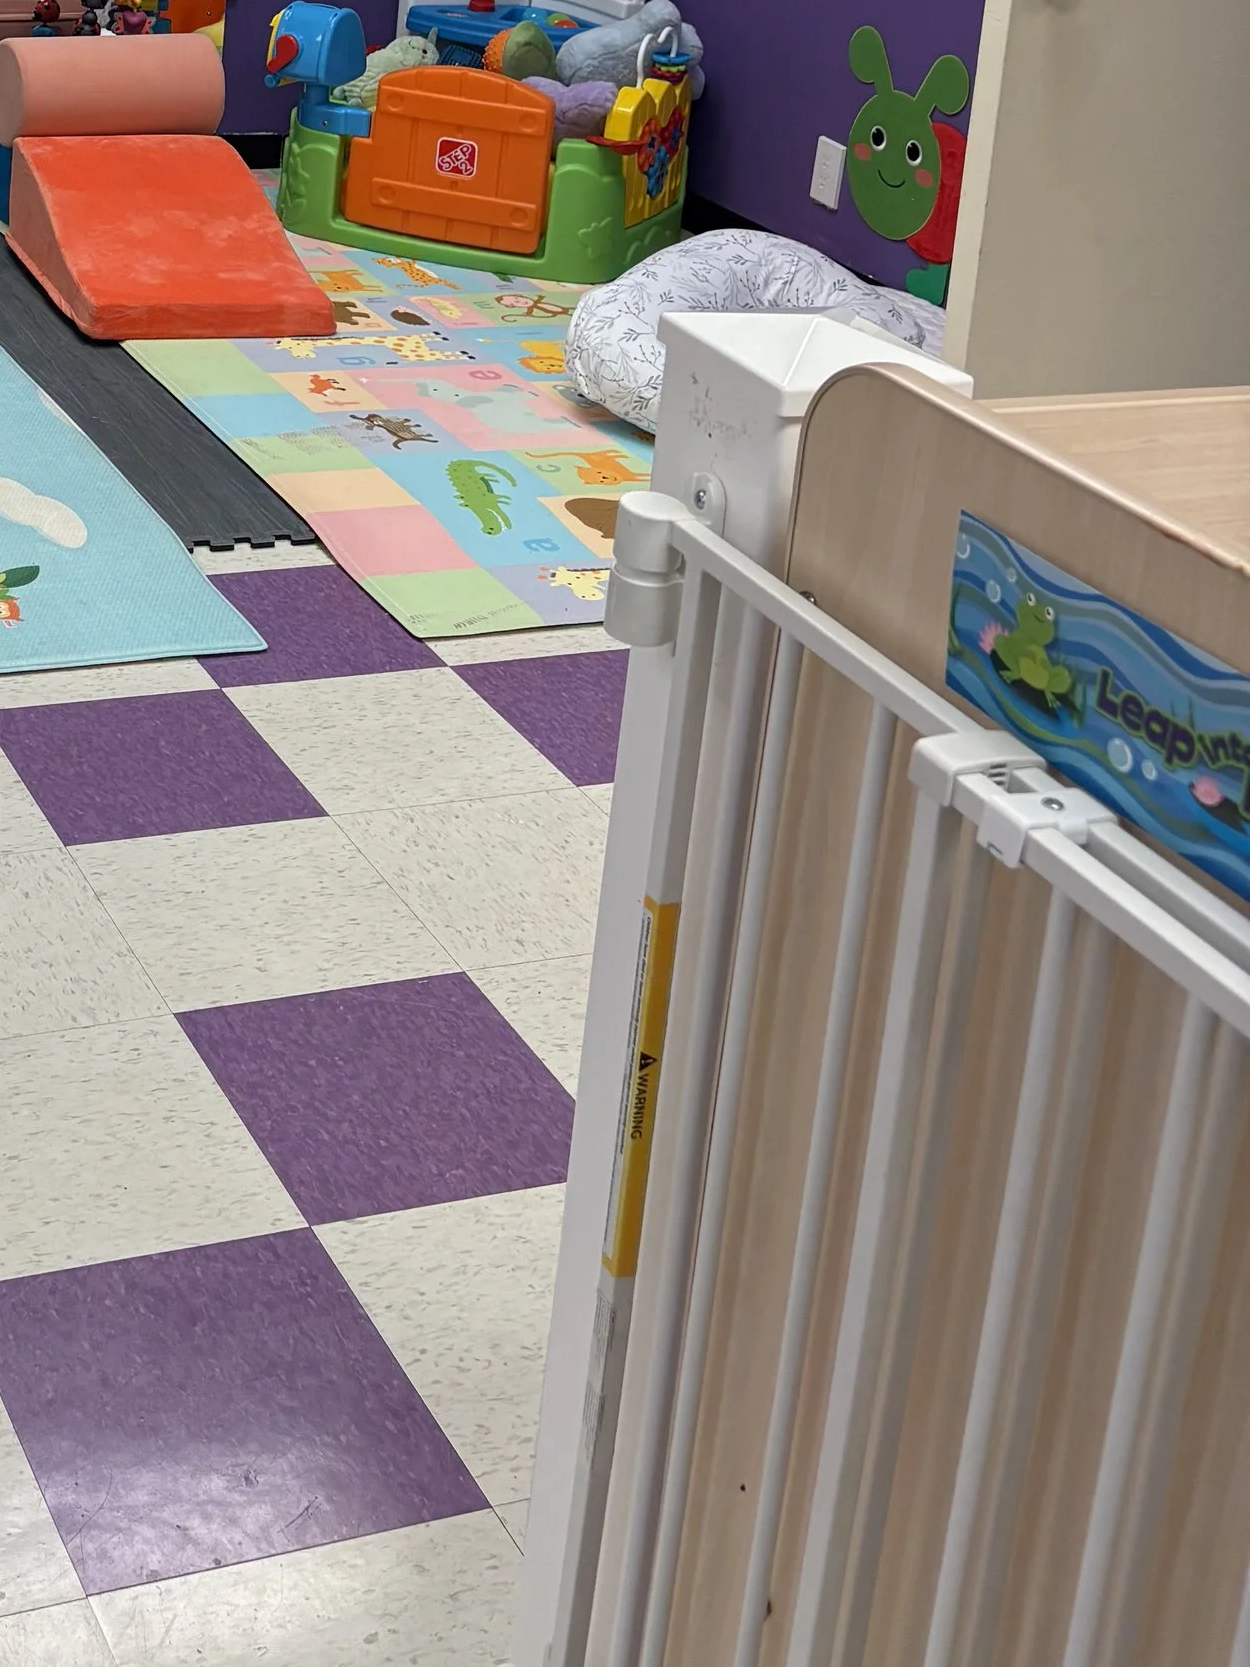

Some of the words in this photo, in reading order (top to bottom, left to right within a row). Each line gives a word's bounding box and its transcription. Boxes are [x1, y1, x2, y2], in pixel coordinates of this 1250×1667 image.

[439, 144, 472, 171] STEP
[468, 370, 503, 381] e
[522, 537, 561, 552] a
[1096, 666, 1197, 770] Leap
[630, 1072, 649, 1140] WARNING
